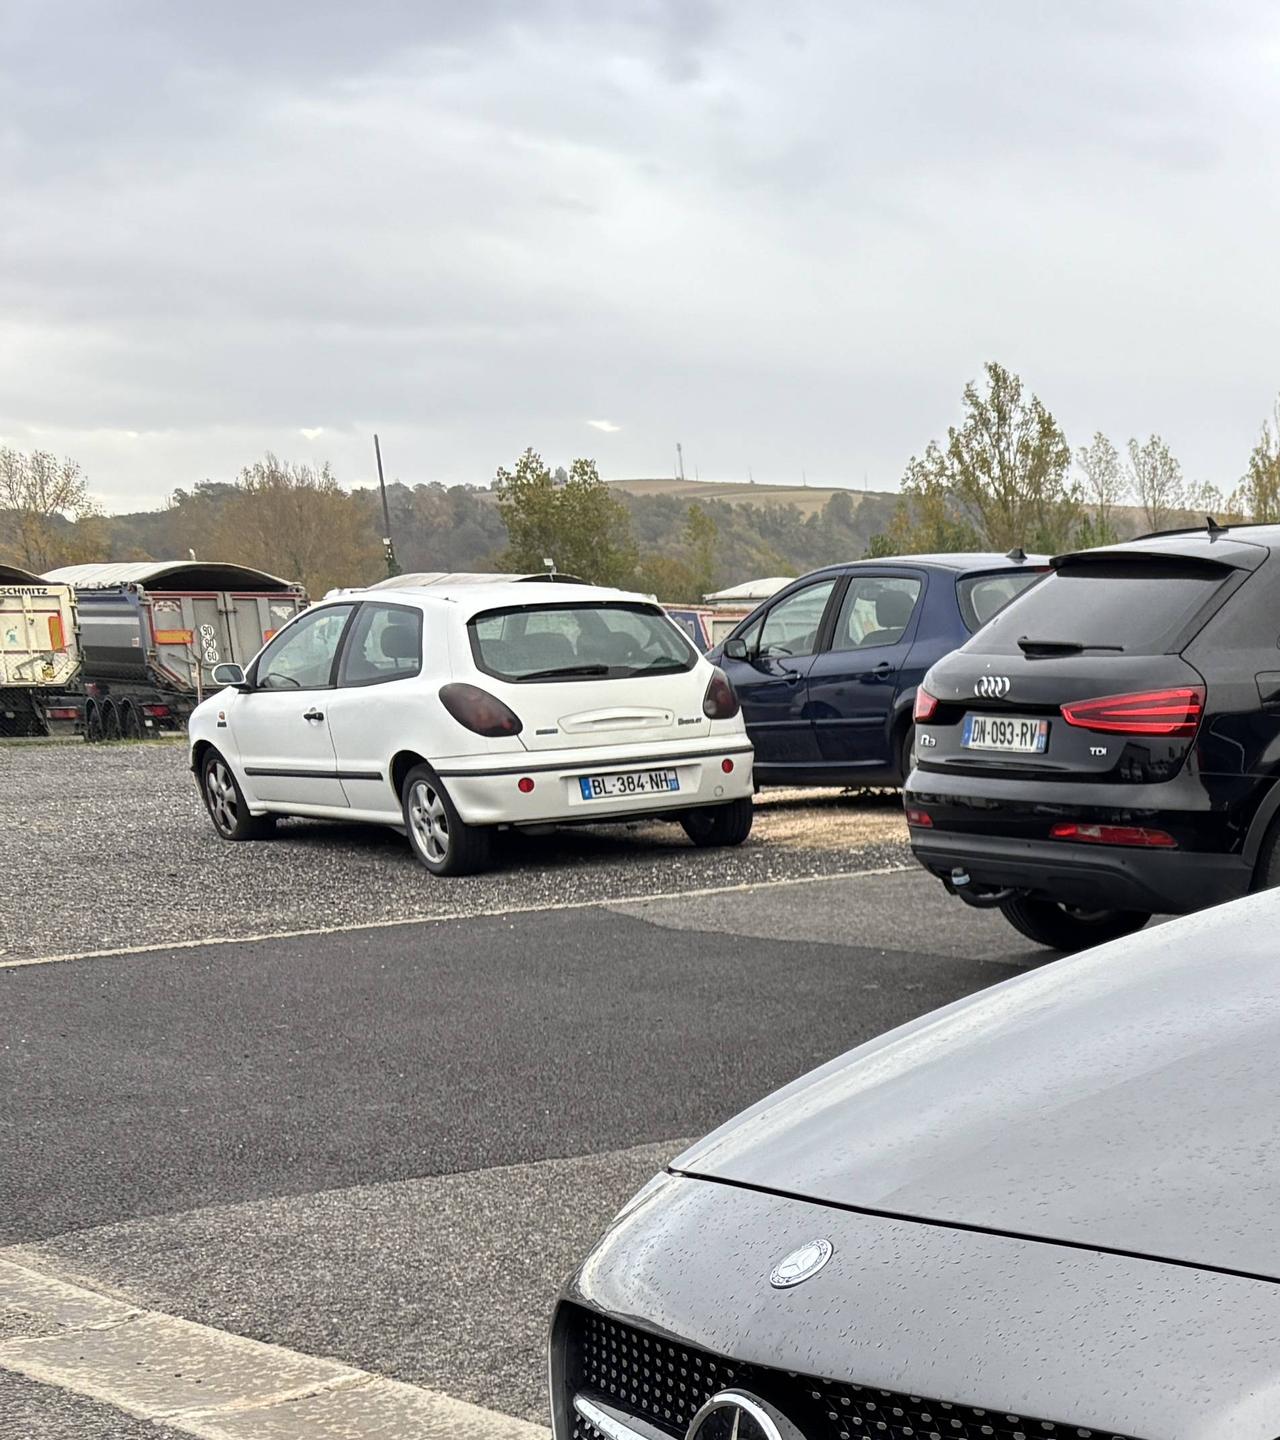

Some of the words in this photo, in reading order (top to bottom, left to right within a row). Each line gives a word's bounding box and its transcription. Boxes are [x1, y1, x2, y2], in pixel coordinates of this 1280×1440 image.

[0, 587, 48, 595] SCHMITZ
[203, 625, 213, 636] 90
[972, 719, 1038, 747] DN-093-RV
[1090, 747, 1106, 756] TDI
[591, 772, 669, 796] BL-384-NH
